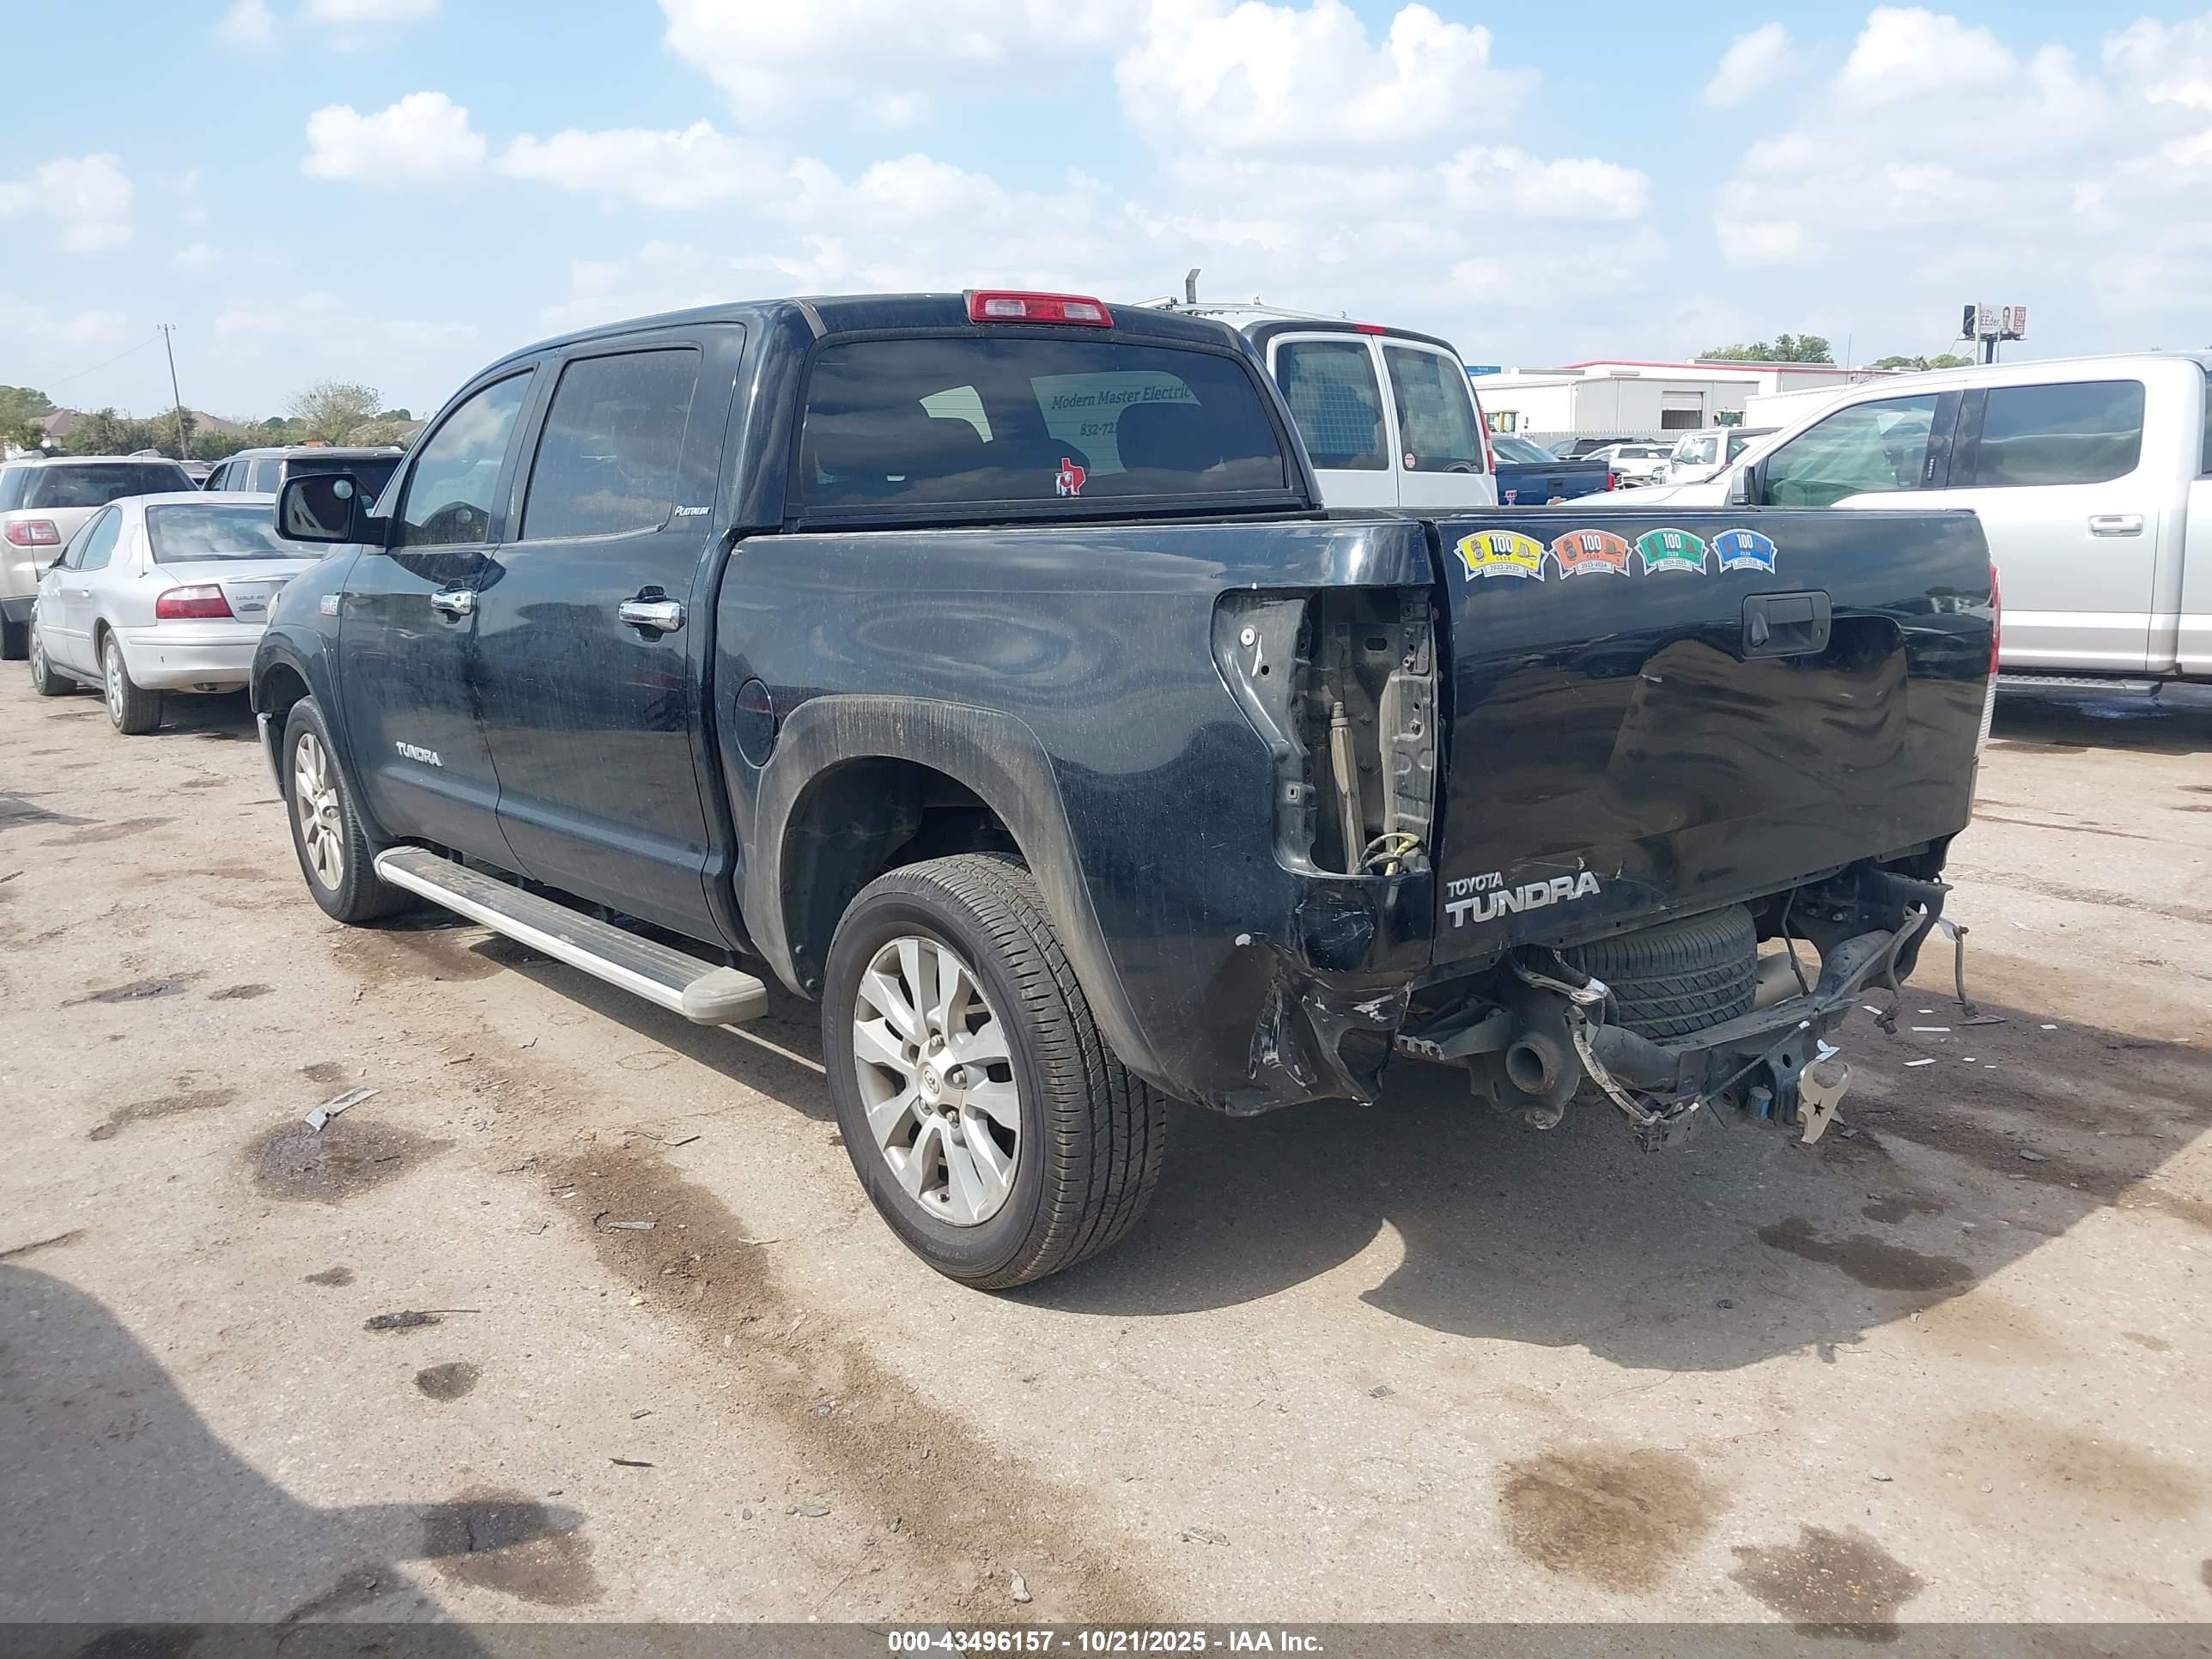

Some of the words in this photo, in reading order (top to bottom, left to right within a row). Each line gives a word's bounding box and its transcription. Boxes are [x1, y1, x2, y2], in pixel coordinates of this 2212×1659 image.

[1051, 392, 1096, 409] Modern
[1097, 390, 1141, 405] Master
[1490, 535, 1514, 555] 100
[1580, 534, 1602, 552] 100
[1662, 532, 1681, 550] 100
[1736, 533, 1753, 550] 100
[1490, 563, 1520, 572] 2022-2023
[396, 741, 444, 767] TUNDRA
[1446, 872, 1504, 897] TOYOTA
[1444, 871, 1601, 928] TUNDRA
